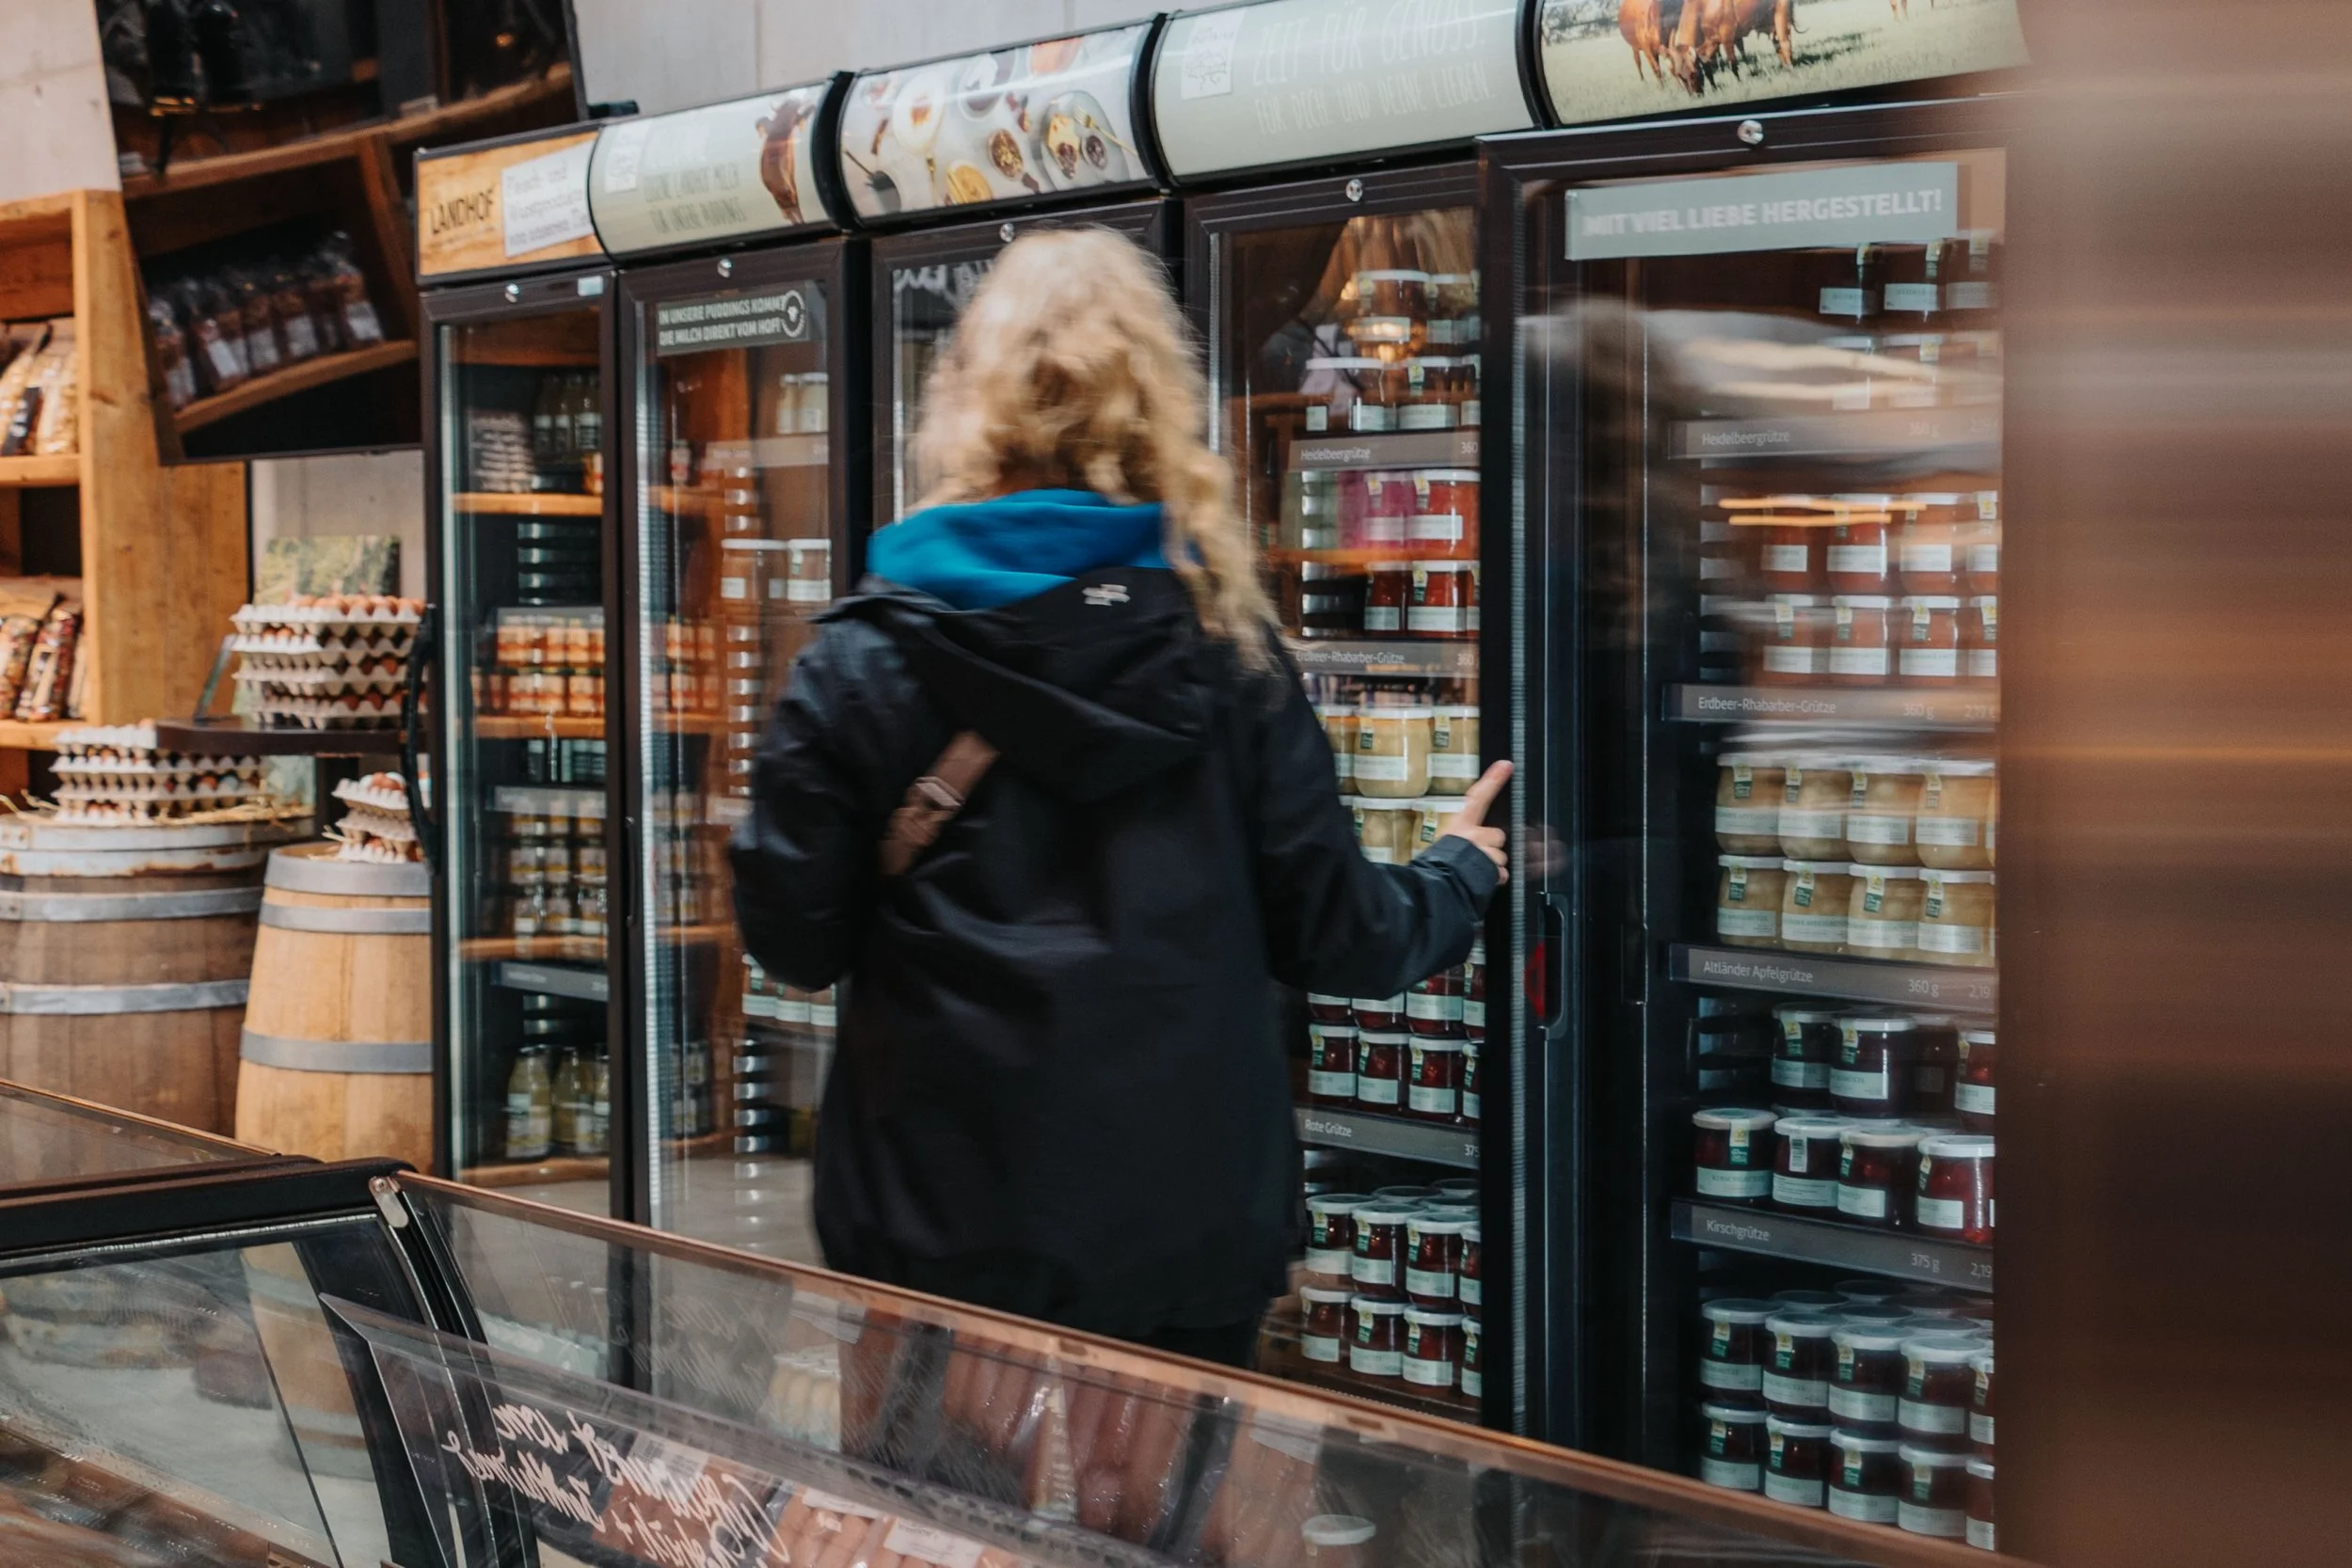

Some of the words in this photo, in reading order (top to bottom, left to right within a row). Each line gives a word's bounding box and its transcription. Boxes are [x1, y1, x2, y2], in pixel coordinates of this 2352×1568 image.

[1252, 18, 1310, 86] ZEIT
[1319, 1, 1367, 73] FÜR
[1254, 89, 1287, 135] FÜR
[1292, 88, 1332, 130] DICH
[1338, 81, 1370, 122] UND
[1377, 71, 1427, 117] DEINE
[430, 186, 494, 235] LANDHOF
[1582, 214, 1628, 236] MIT
[1629, 210, 1683, 233] VIEL
[1687, 204, 1756, 230] LIEBE
[1762, 189, 1942, 225] HERGESTELLT!
[660, 309, 670, 325] IN
[670, 305, 704, 325] UNSERE
[706, 299, 750, 319] PUDDINGS
[752, 295, 785, 313] KOMMT
[660, 330, 675, 346] DIE
[675, 326, 702, 343] MILCH
[704, 323, 736, 341] DIREKT
[737, 319, 756, 338] VOM
[1460, 441, 1479, 454] 360
[1702, 430, 1790, 447] Heidelbeergrütze
[1698, 697, 1836, 714] Erdbeer-Rhabarber-Grütze
[1904, 703, 1925, 717] 360
[1703, 960, 1751, 977] Altländer
[1753, 965, 1814, 984] Apfelgrütze
[1908, 979, 1928, 993] 360
[1931, 984, 1940, 997] g
[1969, 984, 1991, 999] 2,19
[1305, 1118, 1324, 1133] Rote
[1325, 1122, 1352, 1137] Grütze
[1707, 1219, 1770, 1242] Kirschgrütze
[1911, 1253, 1930, 1268] 375
[1970, 1262, 1992, 1278] 2,19
